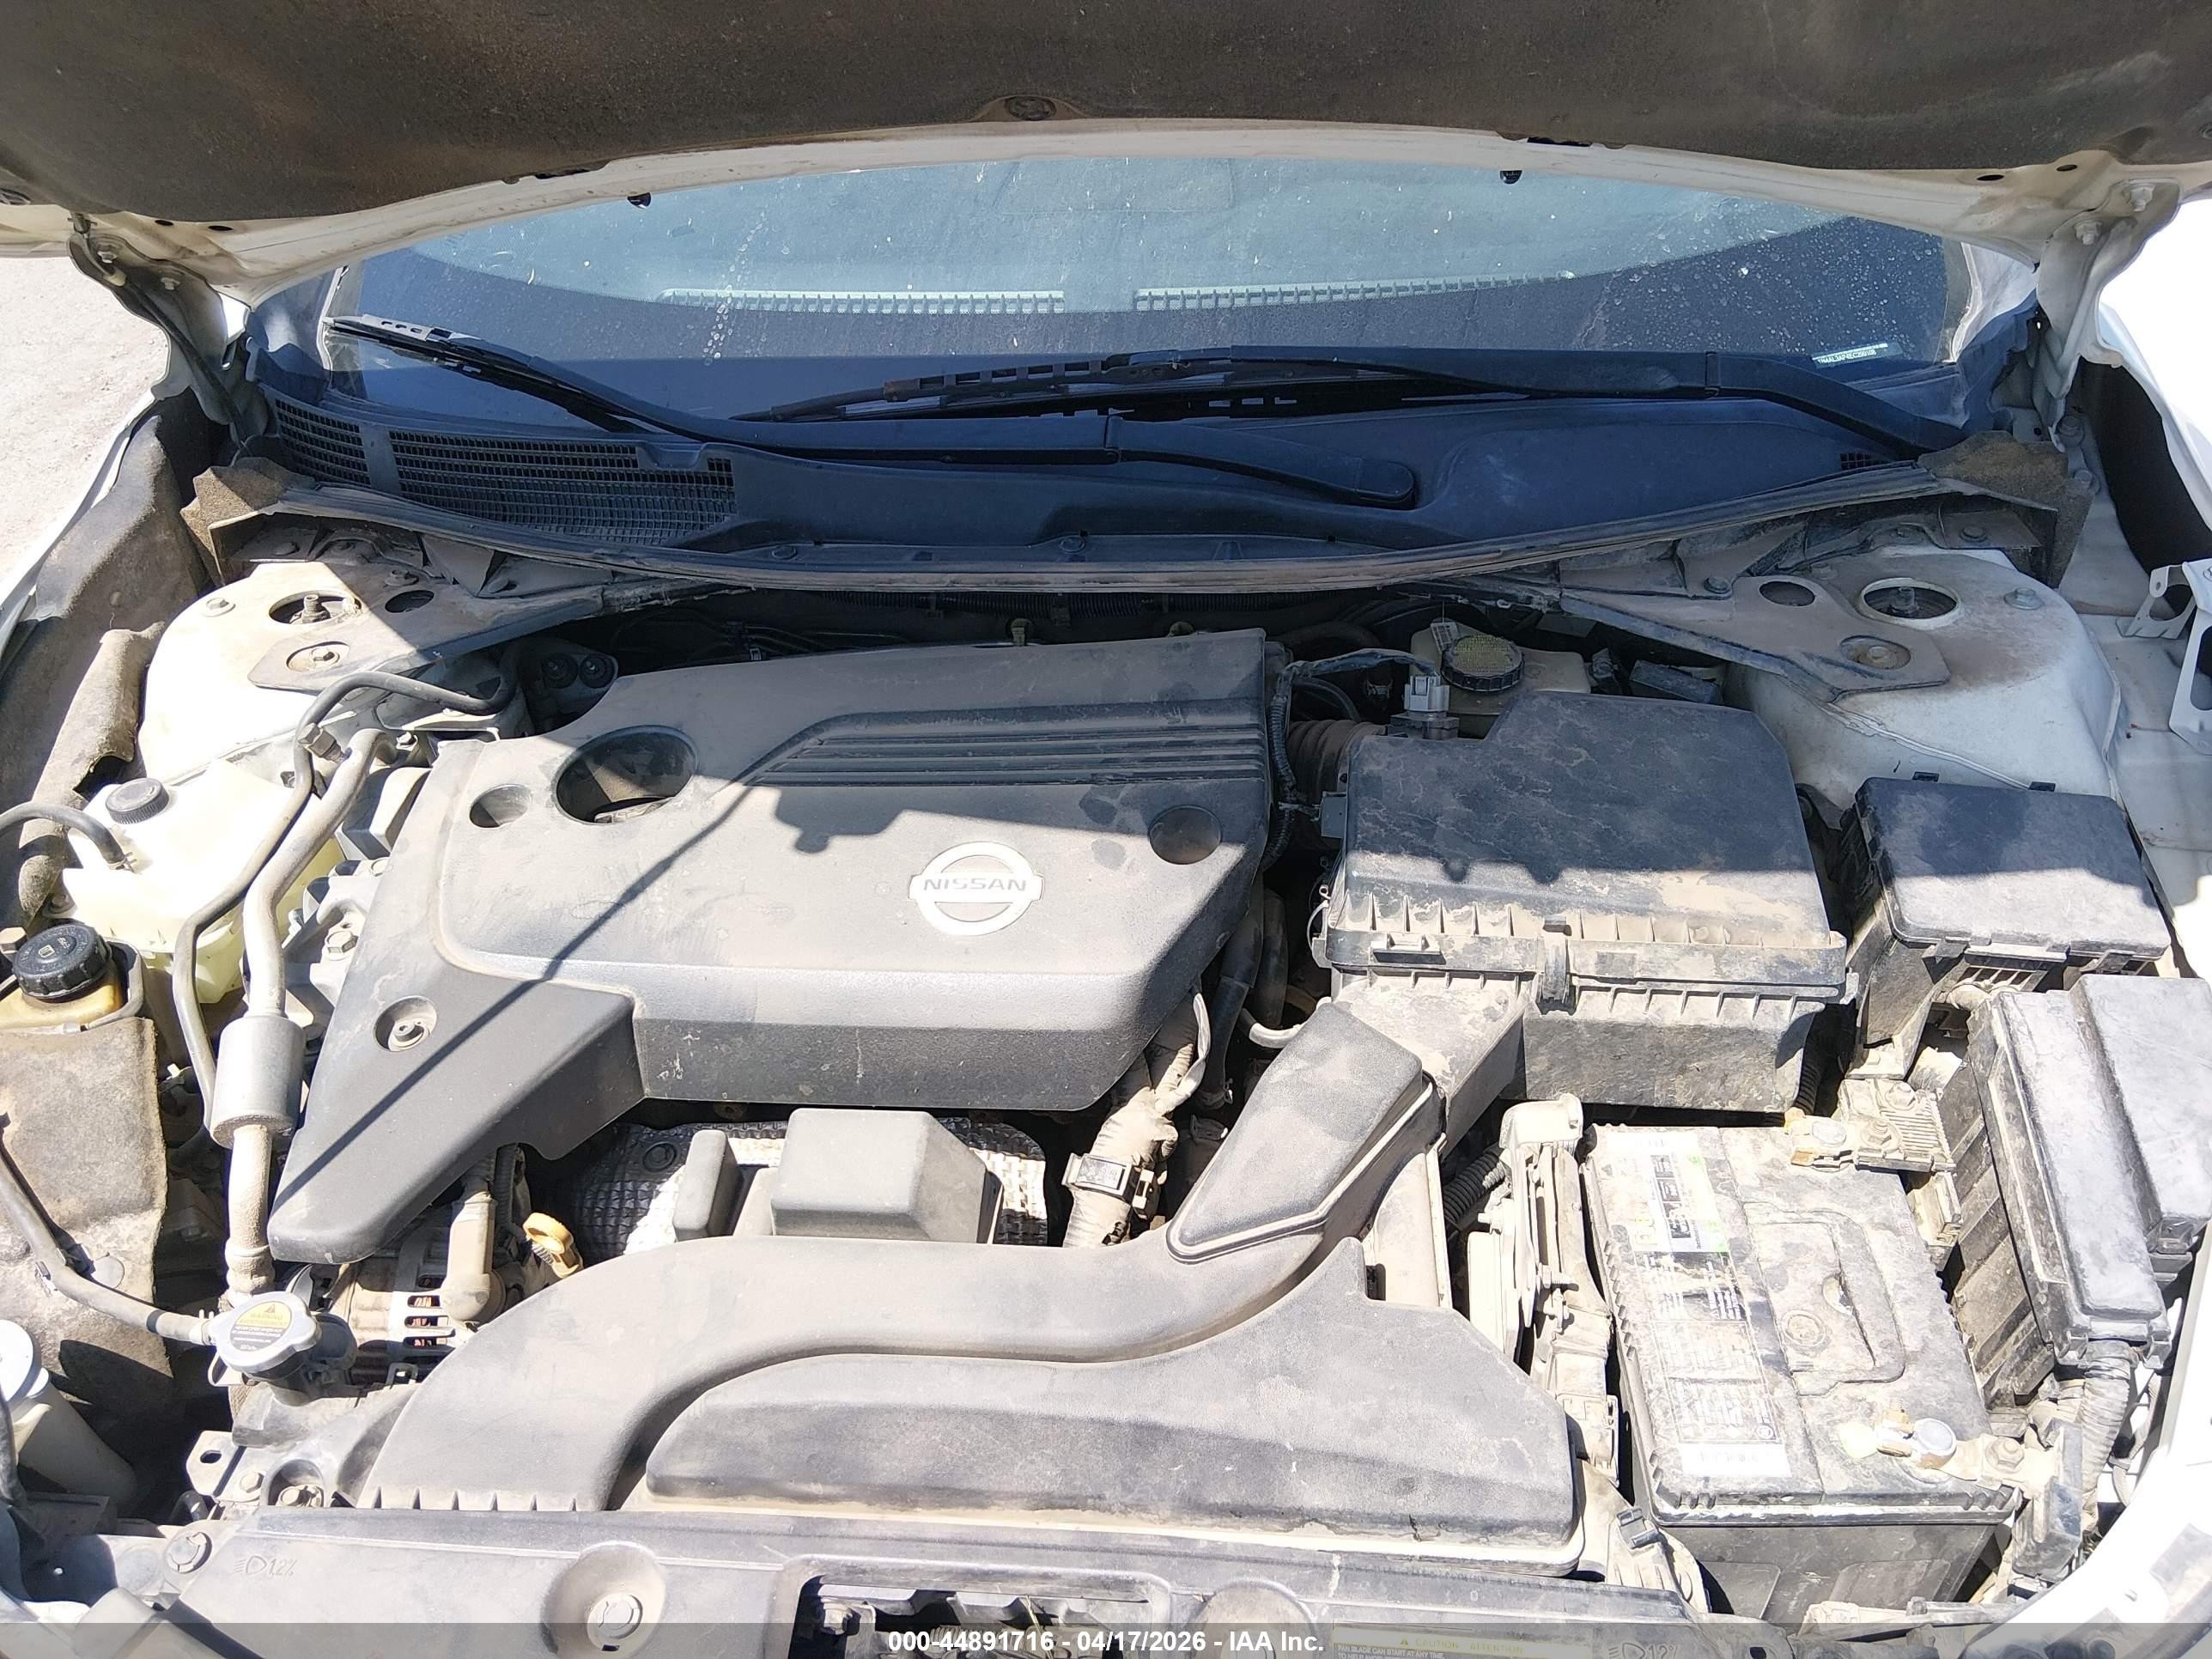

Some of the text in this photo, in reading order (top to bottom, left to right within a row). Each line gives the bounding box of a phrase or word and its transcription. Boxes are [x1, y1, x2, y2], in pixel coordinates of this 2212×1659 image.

[923, 877, 1027, 892] NISSAN
[1415, 1638, 1524, 1654] CAUTION ATTENTION
